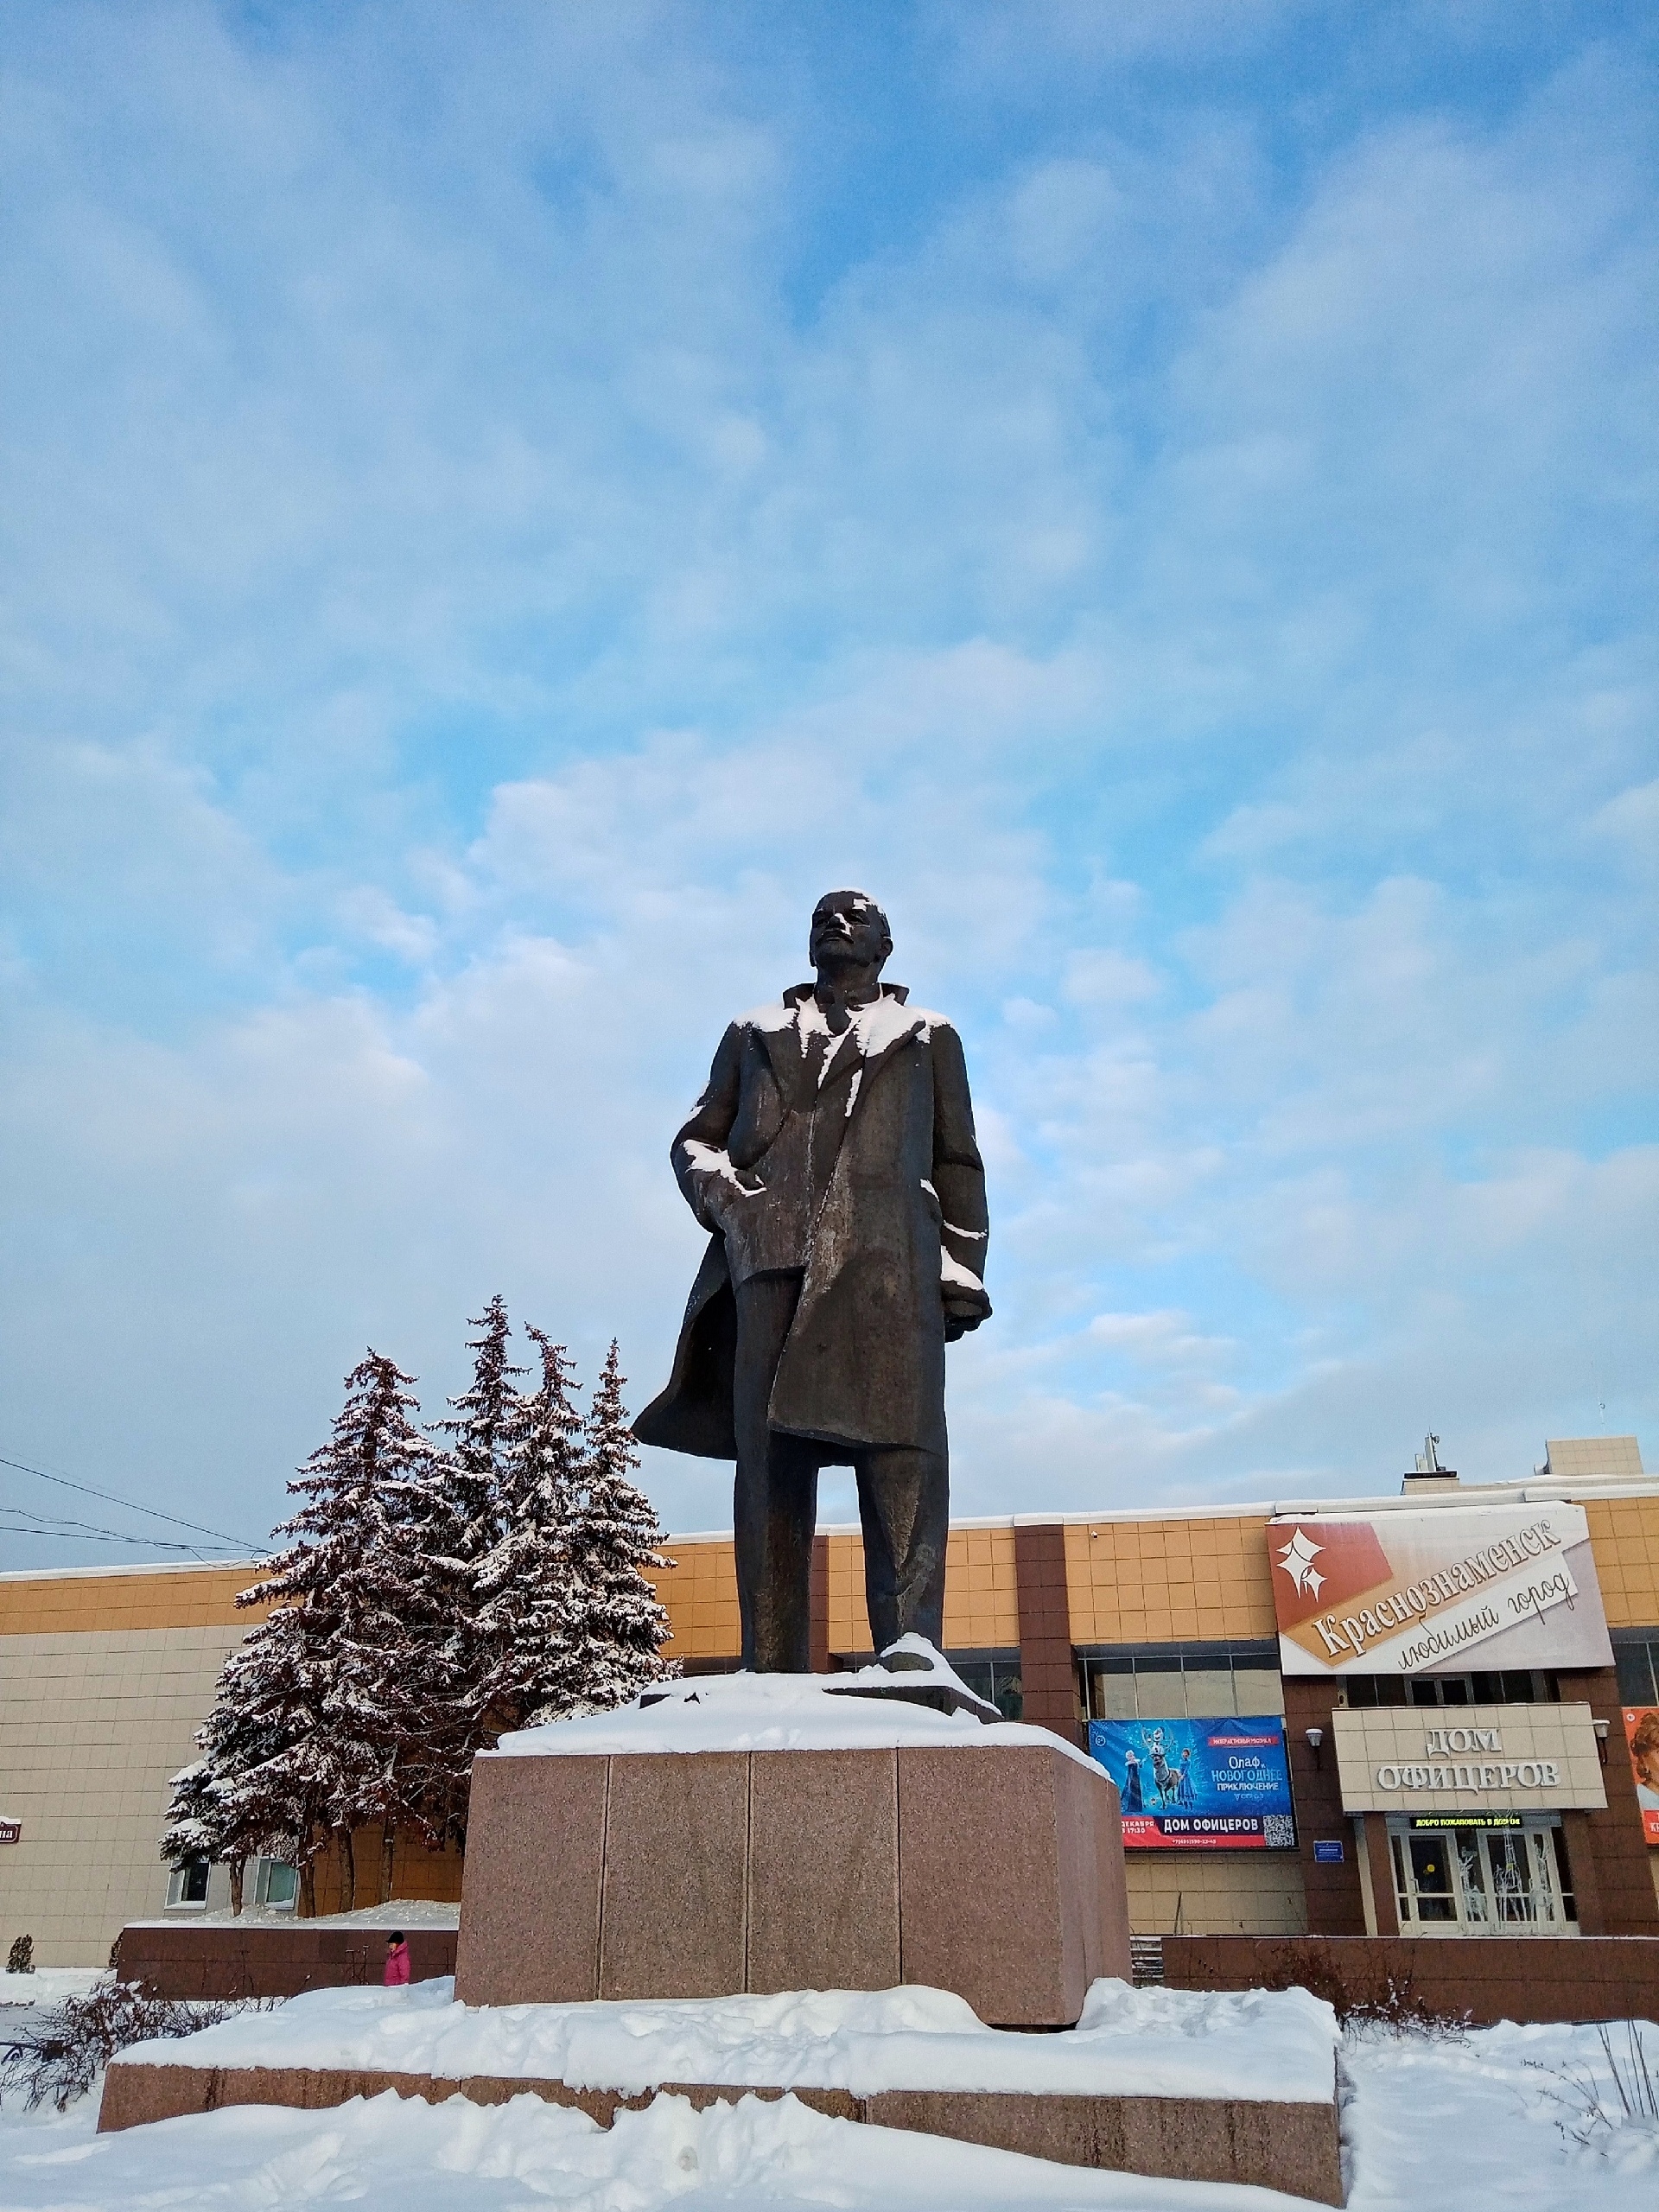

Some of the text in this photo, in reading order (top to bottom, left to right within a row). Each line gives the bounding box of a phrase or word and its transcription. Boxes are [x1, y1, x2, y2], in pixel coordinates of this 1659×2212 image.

[1312, 1519, 1561, 1658] Краснознаменск
[1398, 1572, 1574, 1670] любимый город
[1426, 1729, 1502, 1758] ДОМ
[1229, 1756, 1260, 1769] Олаф
[1211, 1770, 1282, 1782] НОВОГОДНЕЕ
[1217, 1783, 1279, 1791] ПРИКЛЮЧЕНИЕ
[1377, 1762, 1560, 1795] ОФИЦЕРОВ
[1164, 1818, 1259, 1834] ДОМ ОФИЦЕРОВ
